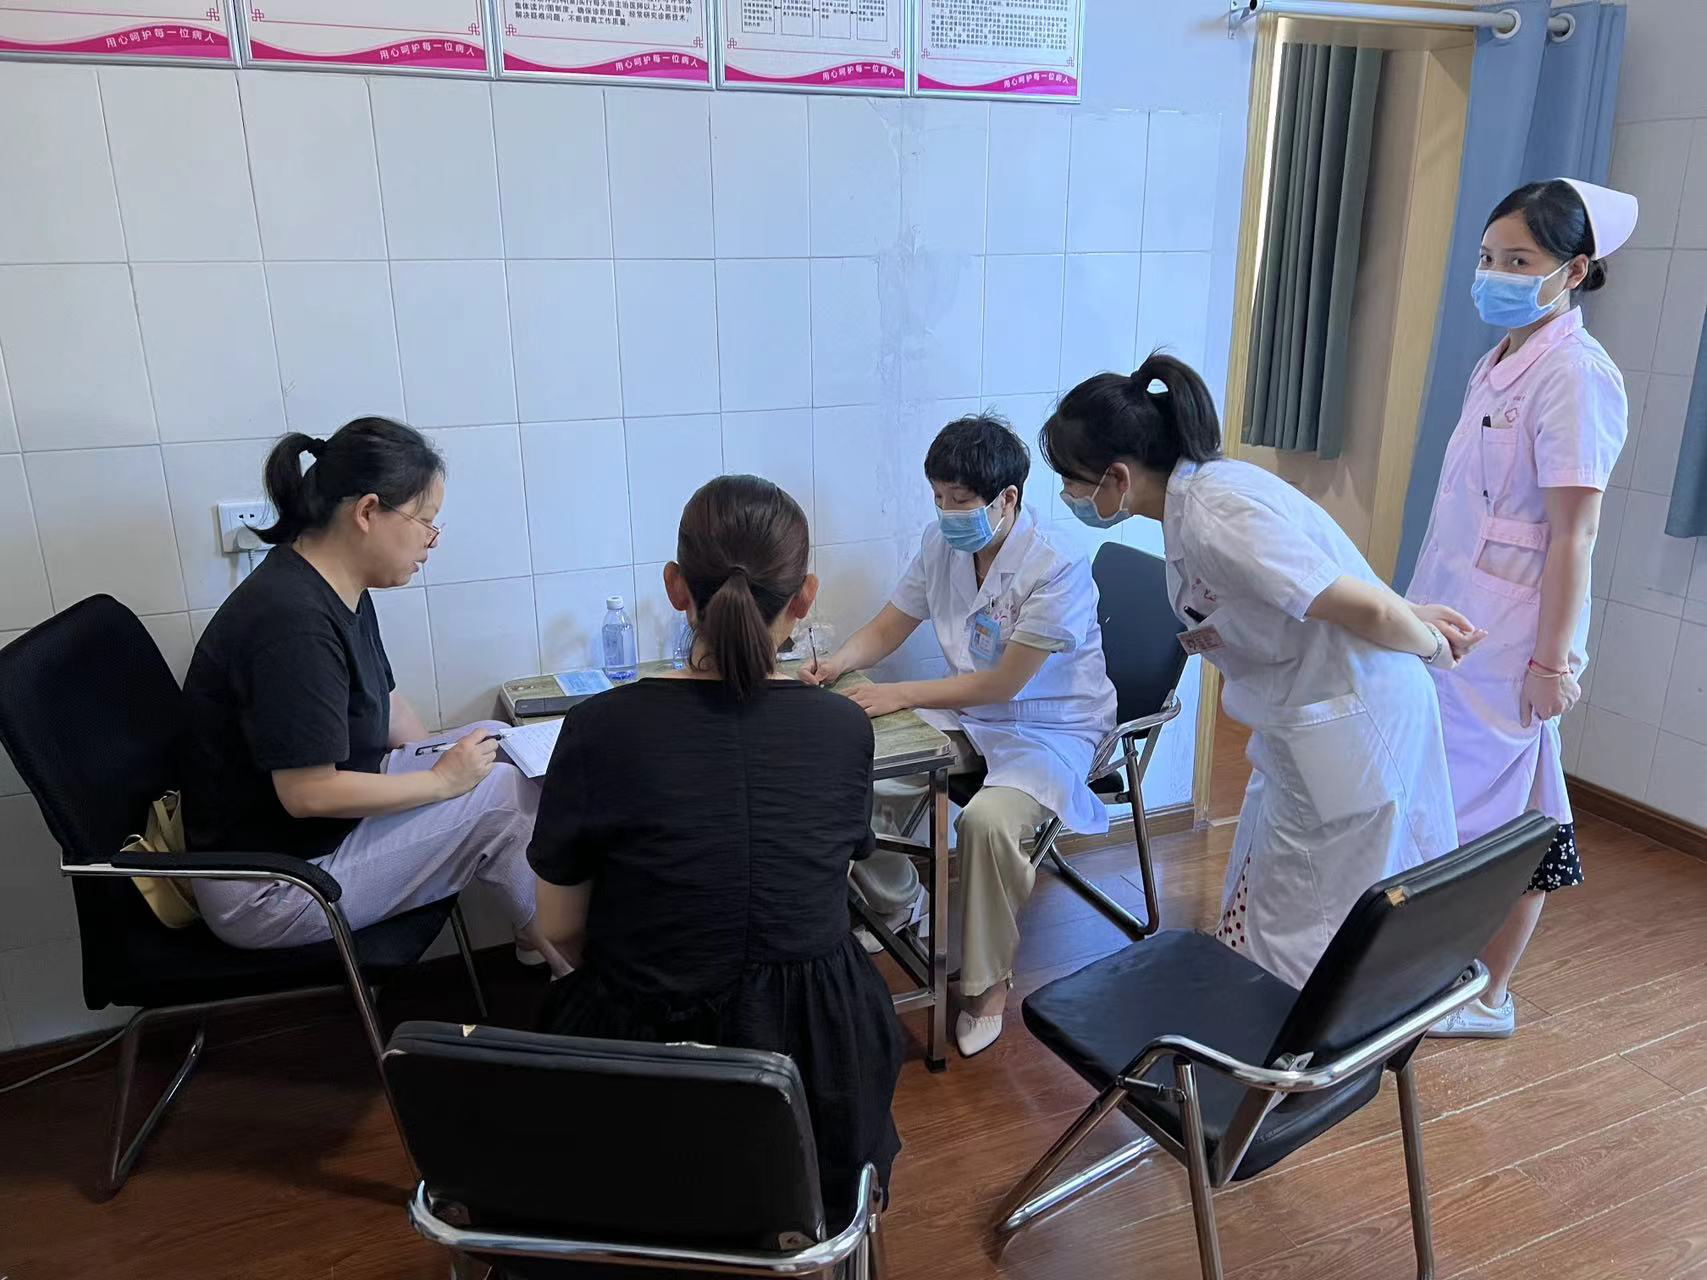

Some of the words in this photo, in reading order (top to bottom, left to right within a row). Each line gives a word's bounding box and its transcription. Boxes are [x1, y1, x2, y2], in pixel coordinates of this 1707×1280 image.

[106, 28, 214, 48] 用心呵护每一位病人
[380, 41, 475, 60] 用心呵护每一位病人
[615, 54, 698, 71] 用心呵护每一位病人
[823, 64, 895, 80] 用心呵护每一位病人
[1004, 72, 1068, 88] 用心呵护每一位病人
